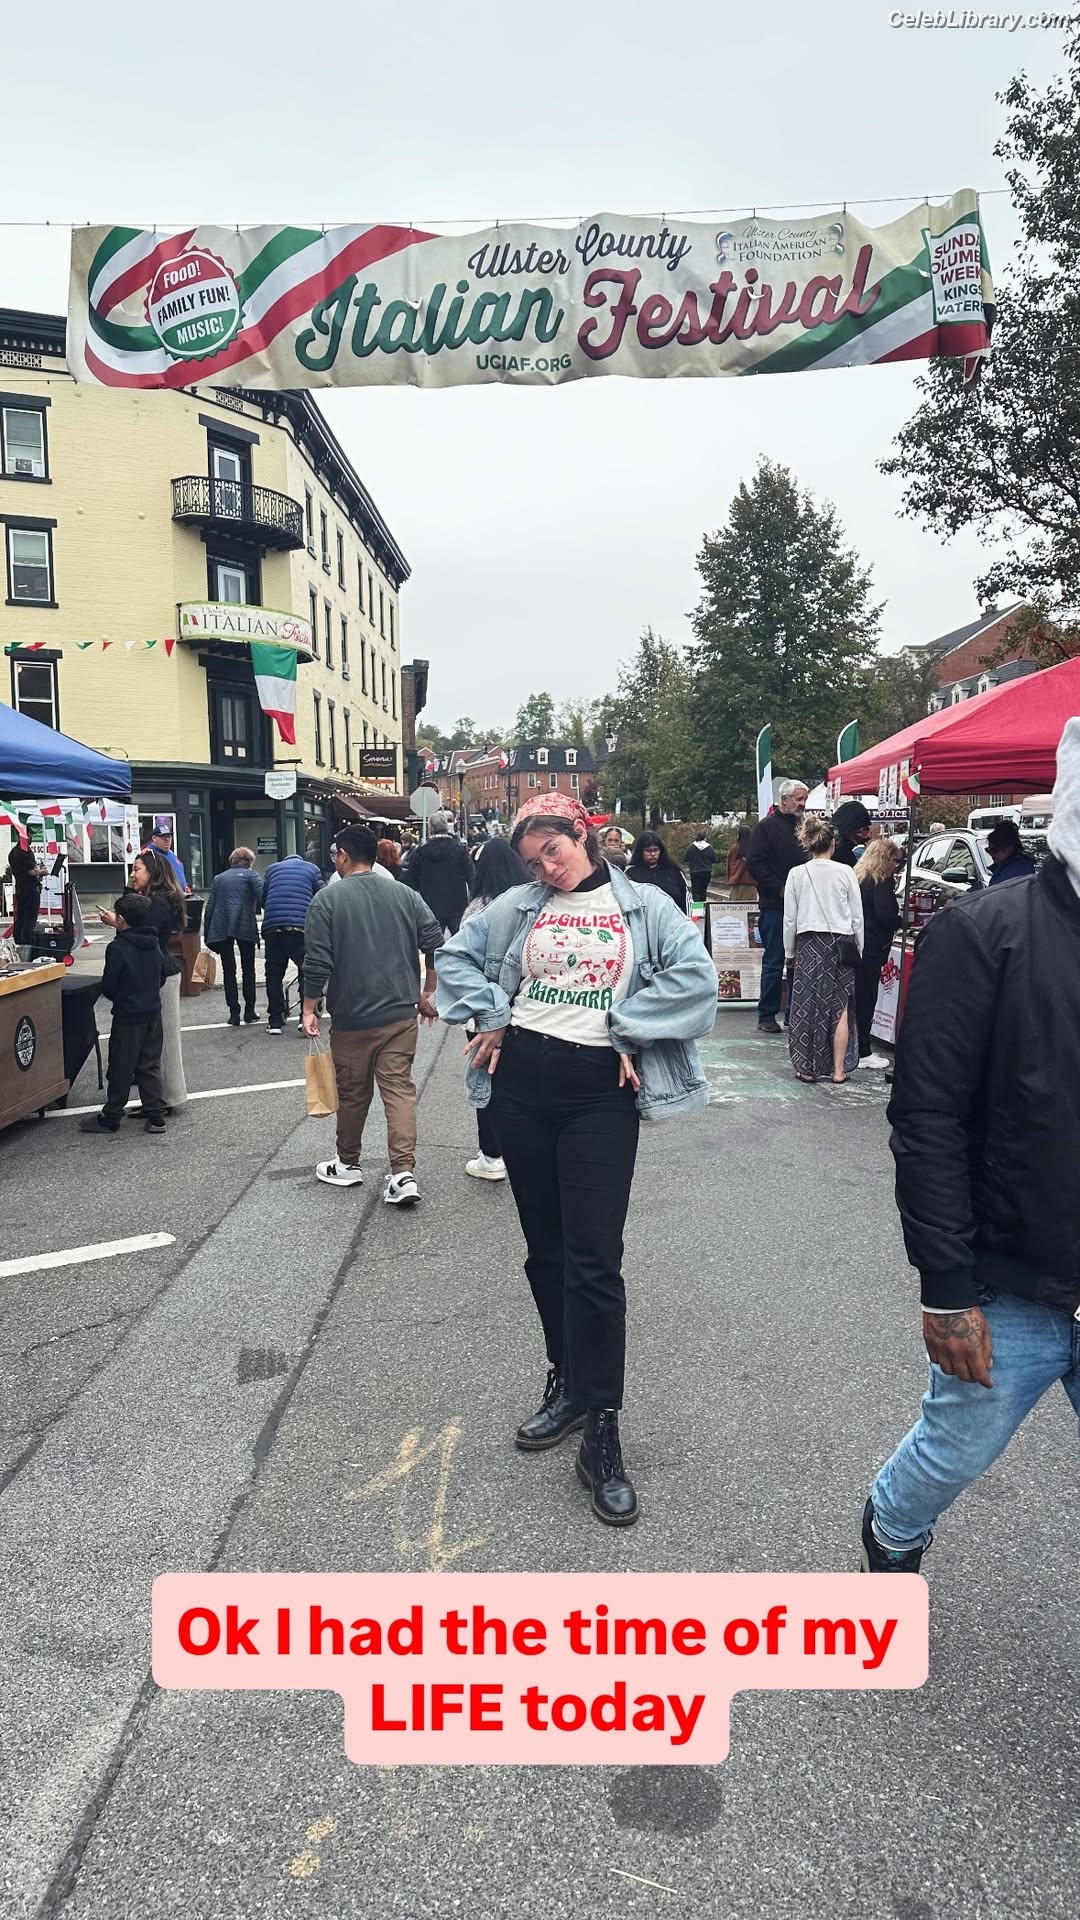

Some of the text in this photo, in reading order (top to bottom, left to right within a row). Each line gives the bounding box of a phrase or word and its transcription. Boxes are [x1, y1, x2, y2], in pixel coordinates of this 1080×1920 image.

[778, 227, 817, 240] County
[467, 223, 692, 279] Ulster County
[739, 249, 822, 262] FOUNDATION
[163, 260, 202, 289] FOOD!
[157, 285, 231, 326] FAMILY FUN!
[295, 244, 881, 373] Italian Festival
[176, 316, 225, 345] MUSIC!
[475, 353, 572, 373] UCIAF.ORG
[203, 614, 278, 636] ITALIAN
[872, 810, 908, 818] POLICE
[534, 912, 625, 934] LEGALIZE
[528, 979, 614, 1011] MARINARA
